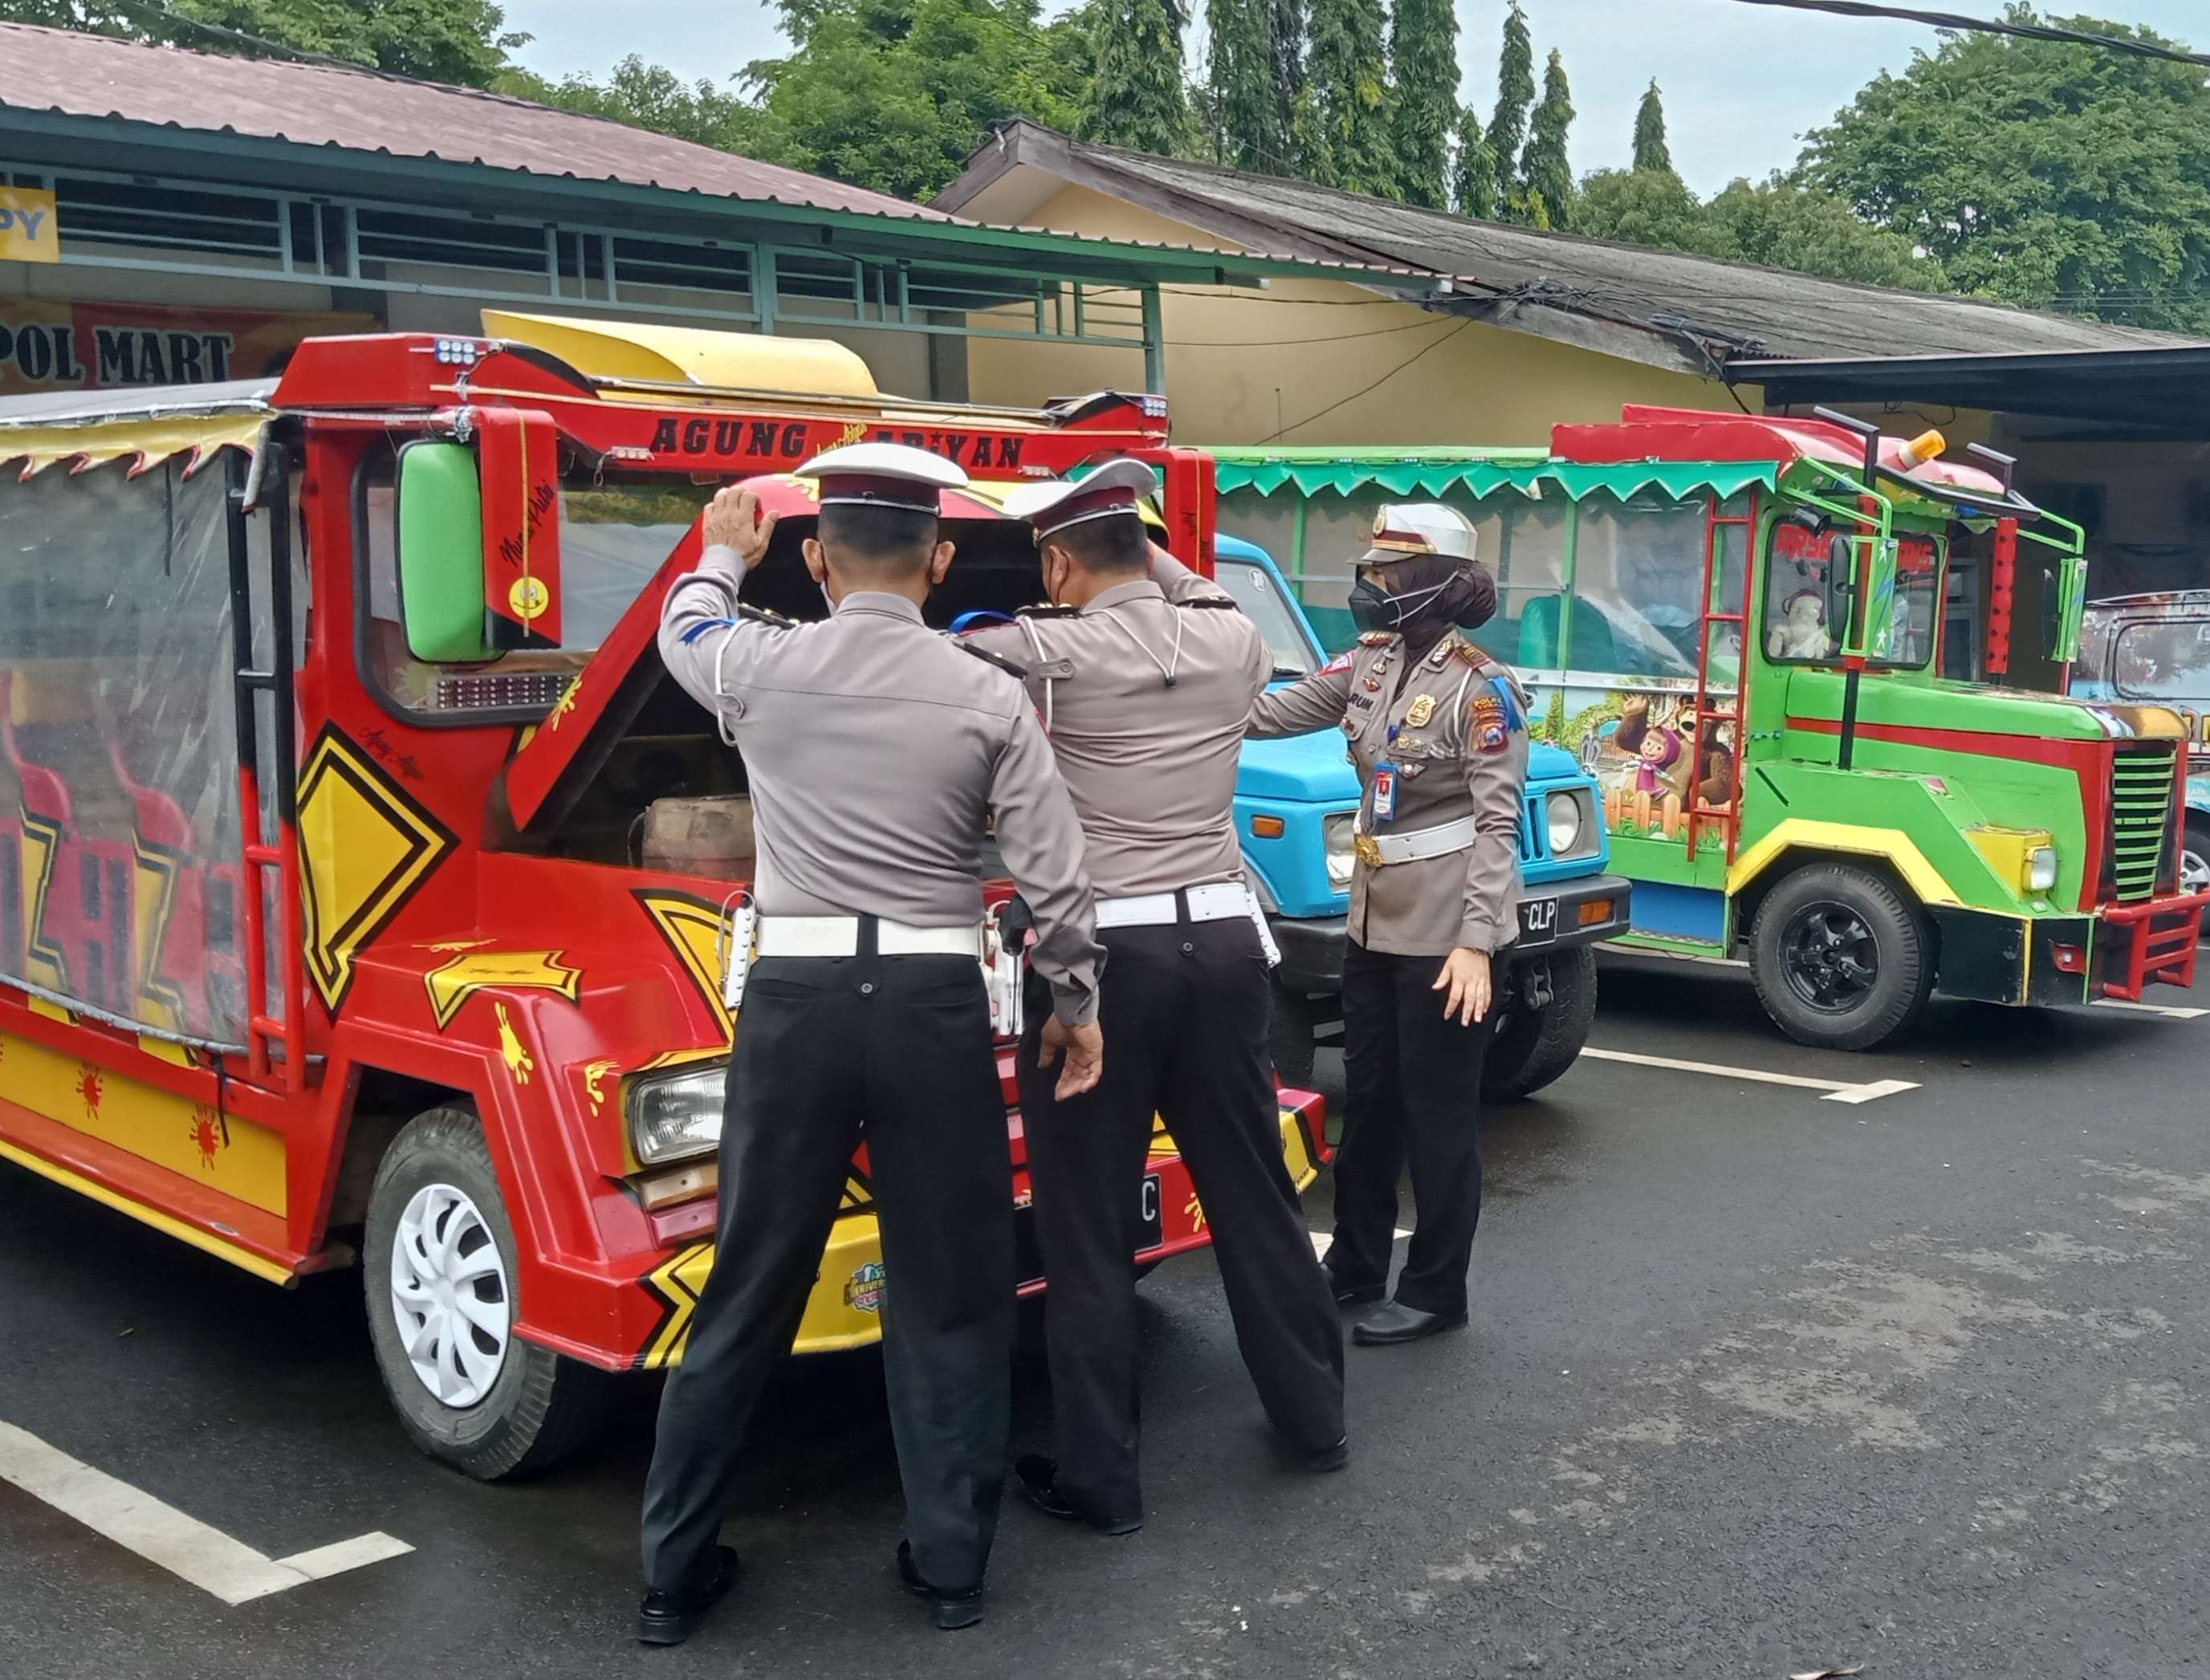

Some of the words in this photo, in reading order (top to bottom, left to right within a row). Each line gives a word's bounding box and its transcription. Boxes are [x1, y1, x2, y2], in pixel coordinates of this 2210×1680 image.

[95, 329, 230, 384] MART
[649, 417, 808, 458] AGUNG
[1528, 901, 1556, 931] CLP
